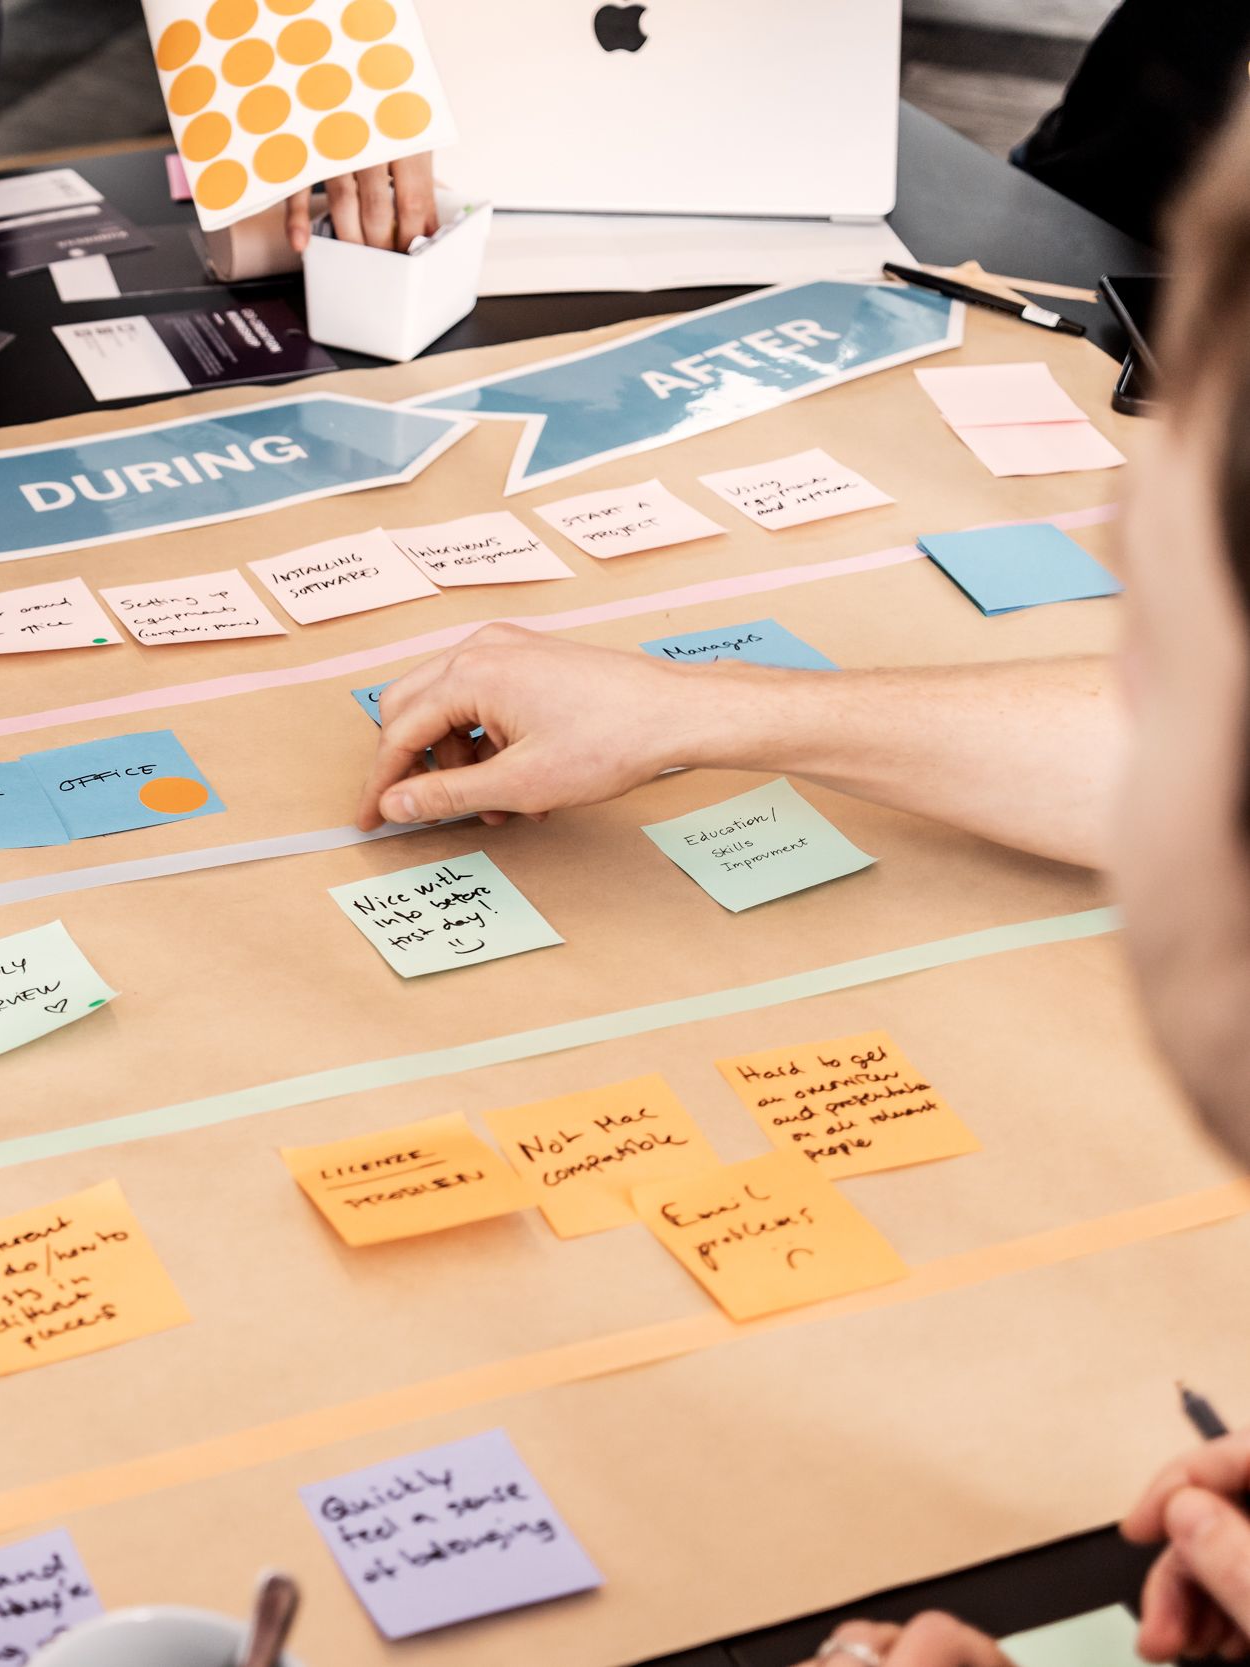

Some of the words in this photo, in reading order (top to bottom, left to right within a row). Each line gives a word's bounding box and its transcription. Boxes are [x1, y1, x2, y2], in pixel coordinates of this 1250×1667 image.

[640, 318, 842, 400] AFTER
[19, 435, 309, 513] DURING
[562, 505, 623, 527] START
[637, 501, 652, 510] A
[582, 516, 661, 542] PROJECT
[408, 536, 502, 559] Interviews
[454, 539, 542, 565] assignment
[272, 553, 363, 585] INSTALLING
[20, 597, 73, 614] around
[120, 597, 199, 611] Setting
[208, 590, 229, 600] up
[20, 621, 74, 634] office
[662, 633, 763, 660] Managers
[711, 840, 754, 859] Skills
[720, 837, 809, 873] Improvment
[353, 893, 411, 916] Nice
[414, 866, 474, 896] with
[373, 909, 423, 928] info
[430, 886, 492, 910] before
[388, 928, 435, 952] first
[737, 1061, 805, 1083] Hard
[817, 1056, 841, 1068] to
[851, 1046, 888, 1069] get
[773, 1106, 820, 1126] and
[518, 1130, 584, 1163] Not
[543, 1132, 689, 1187] compatible
[804, 1138, 872, 1164] people
[661, 1184, 772, 1228] Email
[694, 1207, 815, 1272] problems
[53, 1276, 90, 1290] in
[320, 1469, 453, 1522] Quickly
[338, 1516, 400, 1549] feel
[412, 1512, 438, 1525] a
[446, 1482, 530, 1518] sense
[362, 1557, 397, 1584] of
[398, 1518, 558, 1567] belonging
